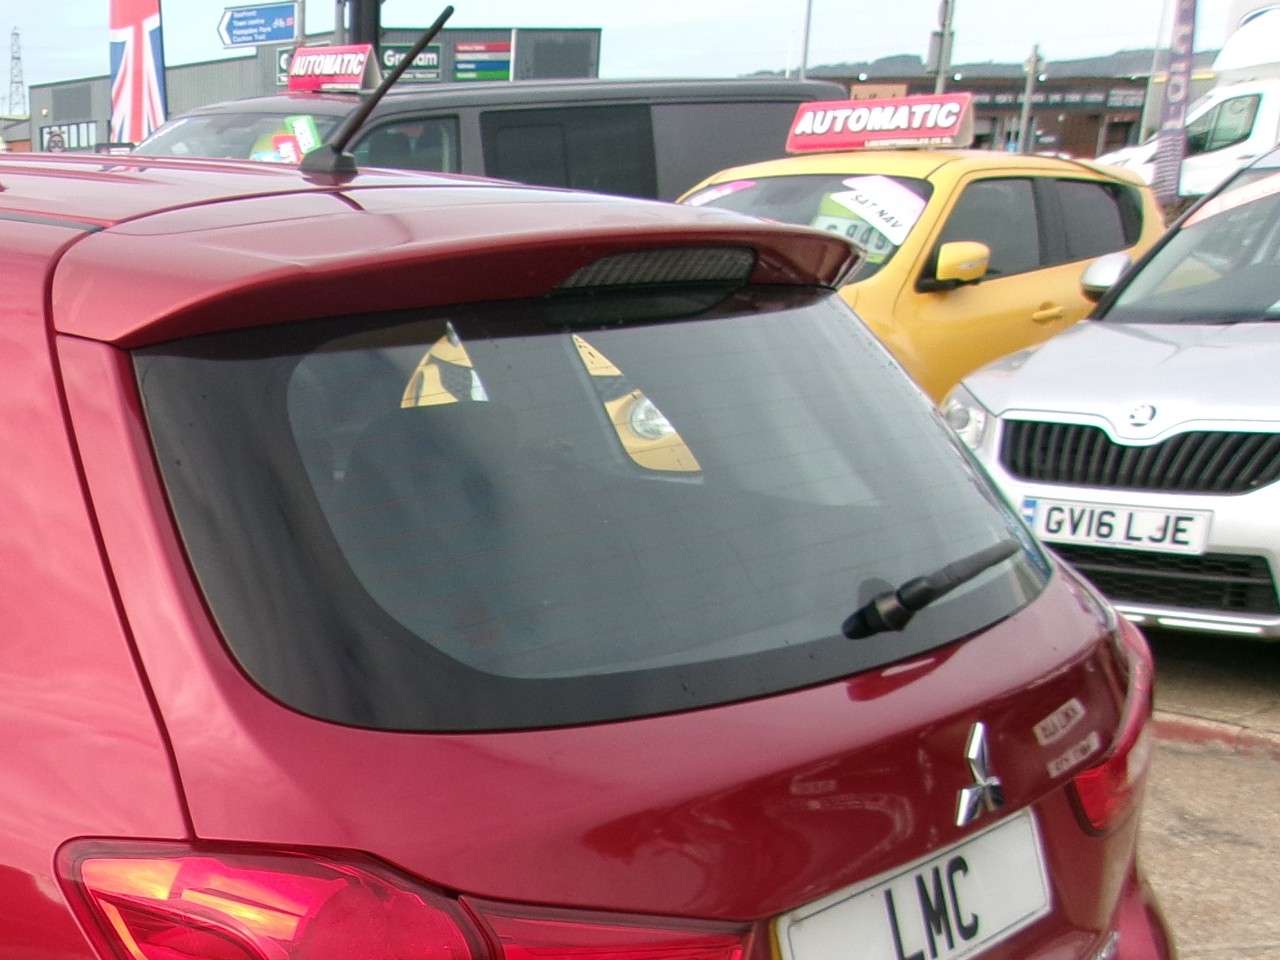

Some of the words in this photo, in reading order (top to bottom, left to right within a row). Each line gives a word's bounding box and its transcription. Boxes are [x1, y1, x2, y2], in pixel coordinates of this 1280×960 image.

[292, 53, 365, 76] AUTOMATIC
[383, 50, 438, 67] Gram
[793, 102, 961, 136] AUTOMATIC
[877, 209, 903, 229] NAV
[1045, 506, 1116, 539] GV16
[1124, 512, 1195, 546] LJE
